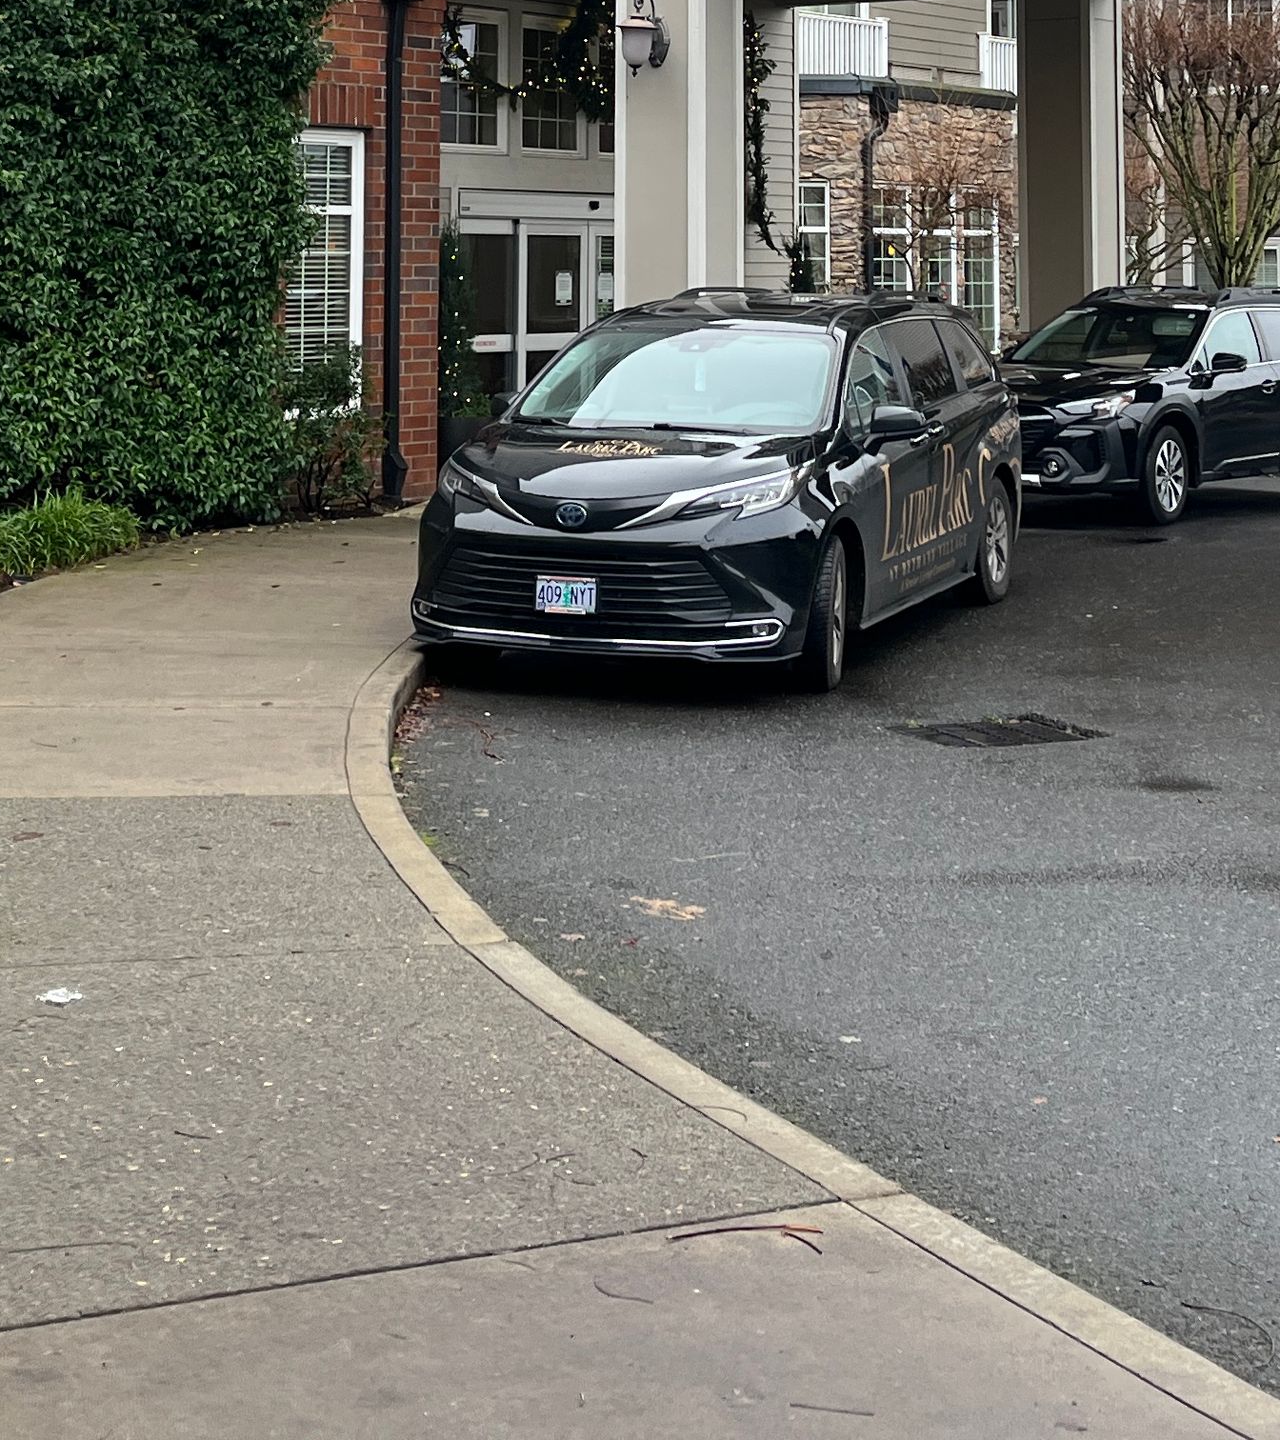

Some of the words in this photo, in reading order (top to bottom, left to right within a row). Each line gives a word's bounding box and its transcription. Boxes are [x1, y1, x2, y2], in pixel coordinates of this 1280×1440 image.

[880, 463, 938, 561] LAUREL
[938, 443, 973, 536] PARC
[538, 585, 562, 603] 409
[570, 586, 595, 606] NYT
